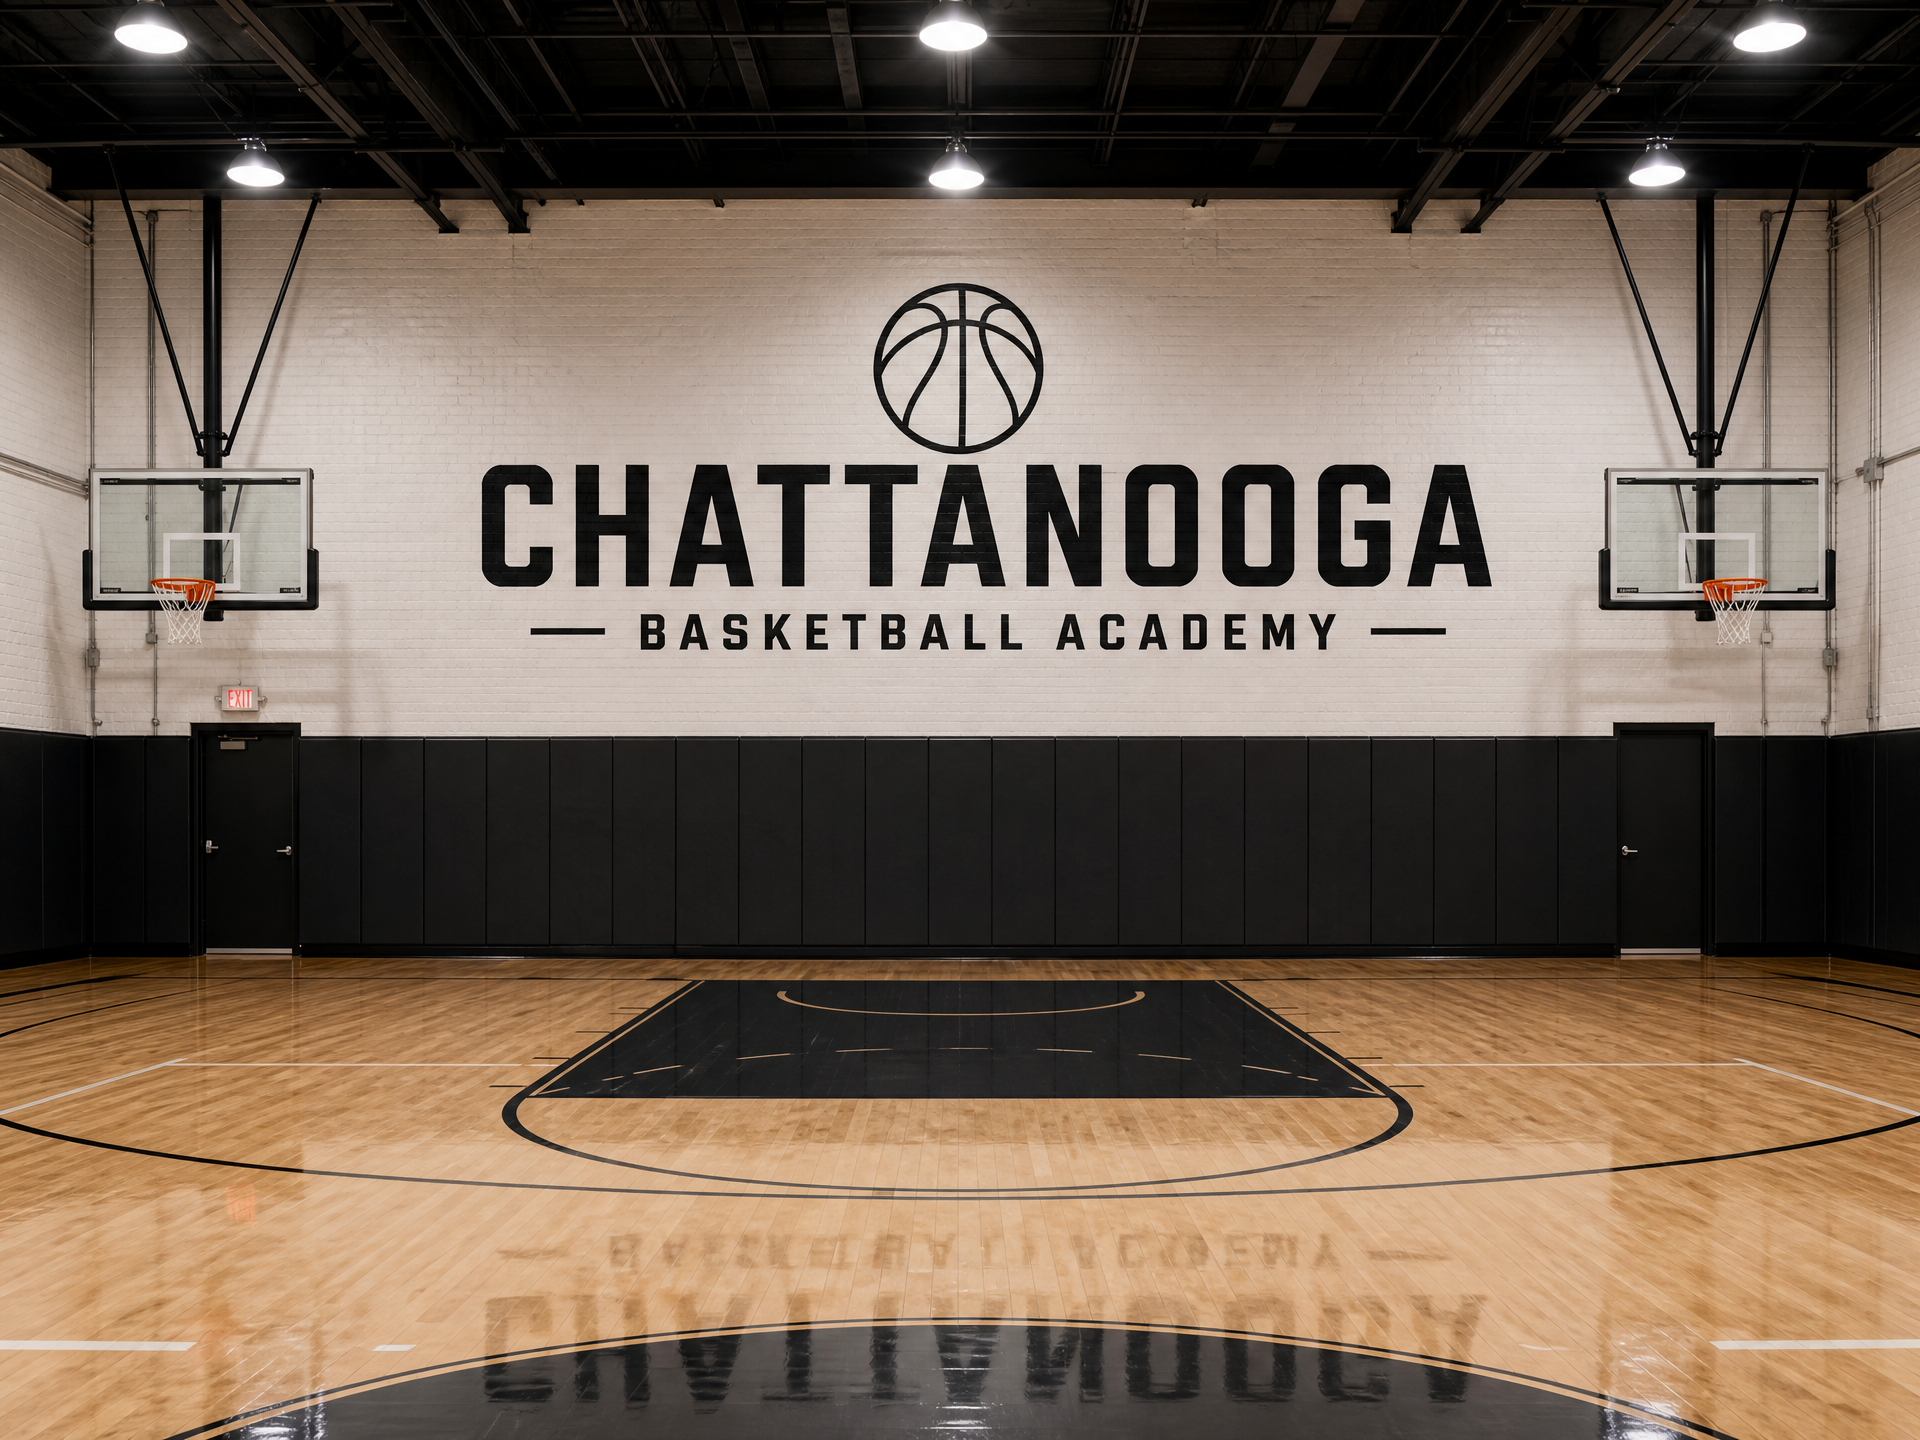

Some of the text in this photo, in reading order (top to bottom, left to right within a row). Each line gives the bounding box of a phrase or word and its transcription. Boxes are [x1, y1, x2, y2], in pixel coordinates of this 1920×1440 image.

[481, 464, 1493, 588] CHATTANOOGA
[640, 613, 1337, 651] BASKETBALL ACADEMY
[227, 689, 252, 708] EXIT
